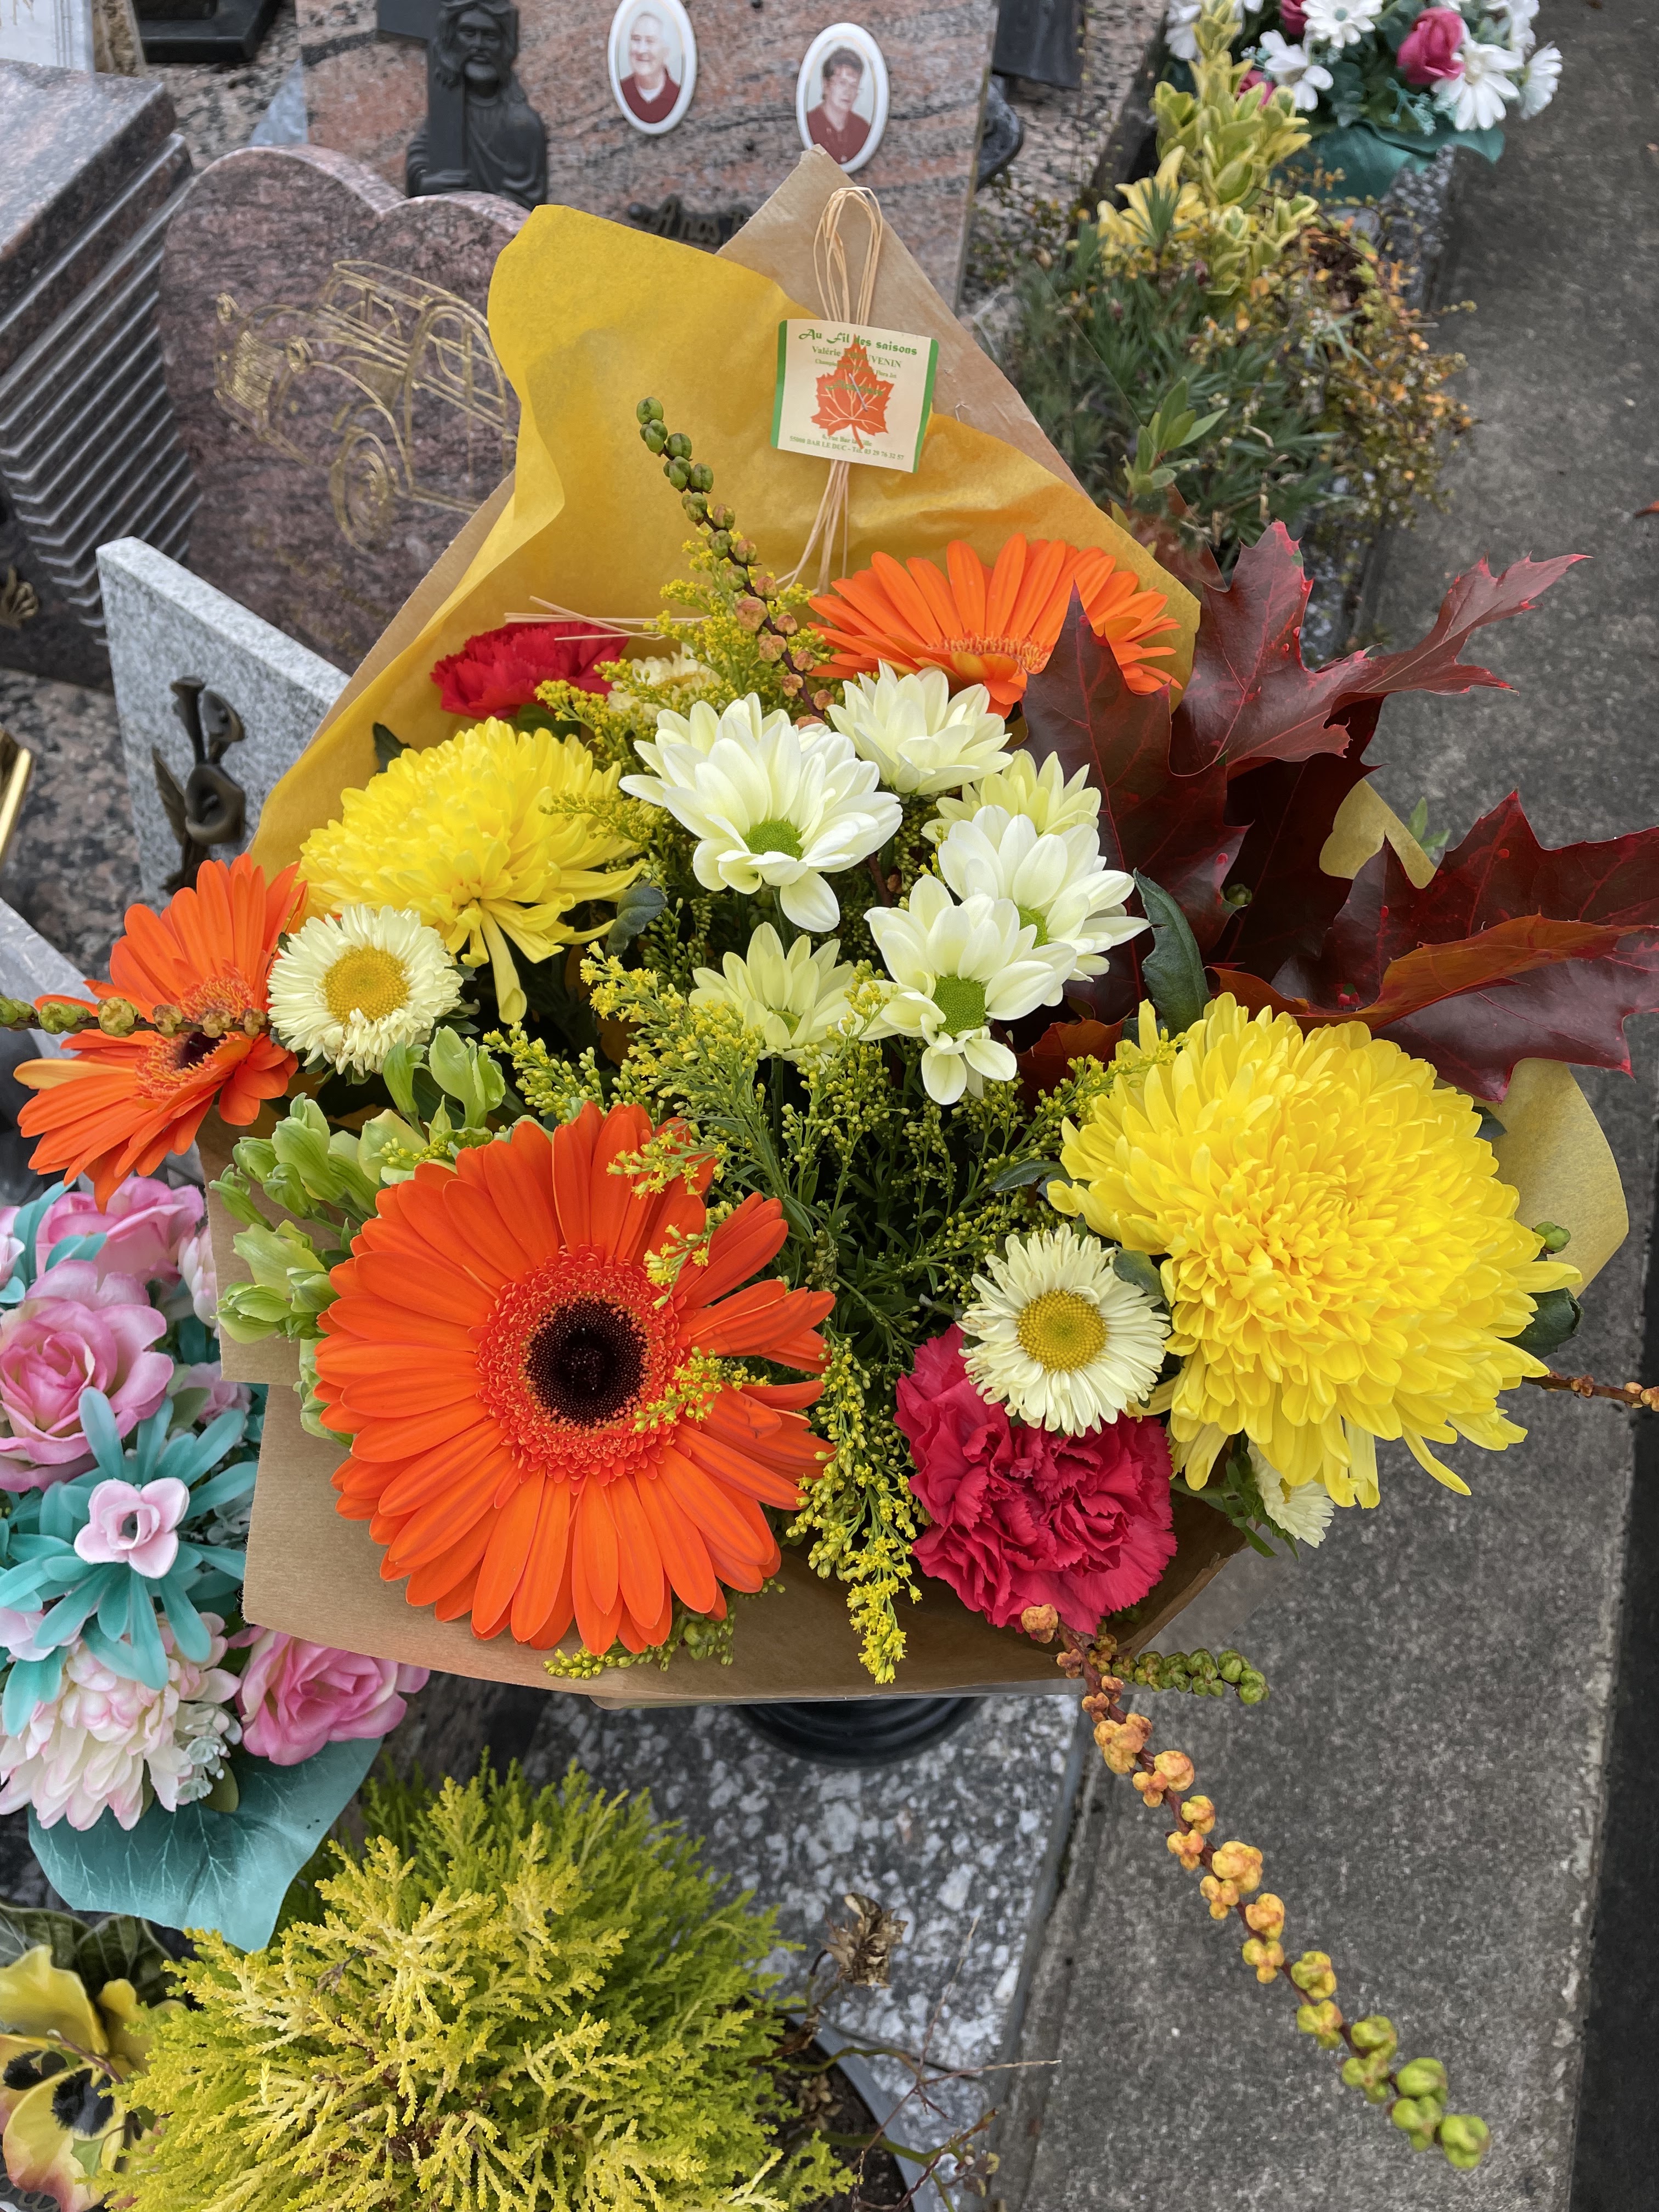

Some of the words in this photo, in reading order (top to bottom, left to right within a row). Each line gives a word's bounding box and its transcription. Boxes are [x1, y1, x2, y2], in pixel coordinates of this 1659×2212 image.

[799, 329, 822, 340] Au
[826, 332, 849, 343] Fil
[854, 335, 871, 346] des
[876, 341, 917, 355] saisons
[812, 346, 841, 357] Valérie
[806, 438, 821, 447] BAR
